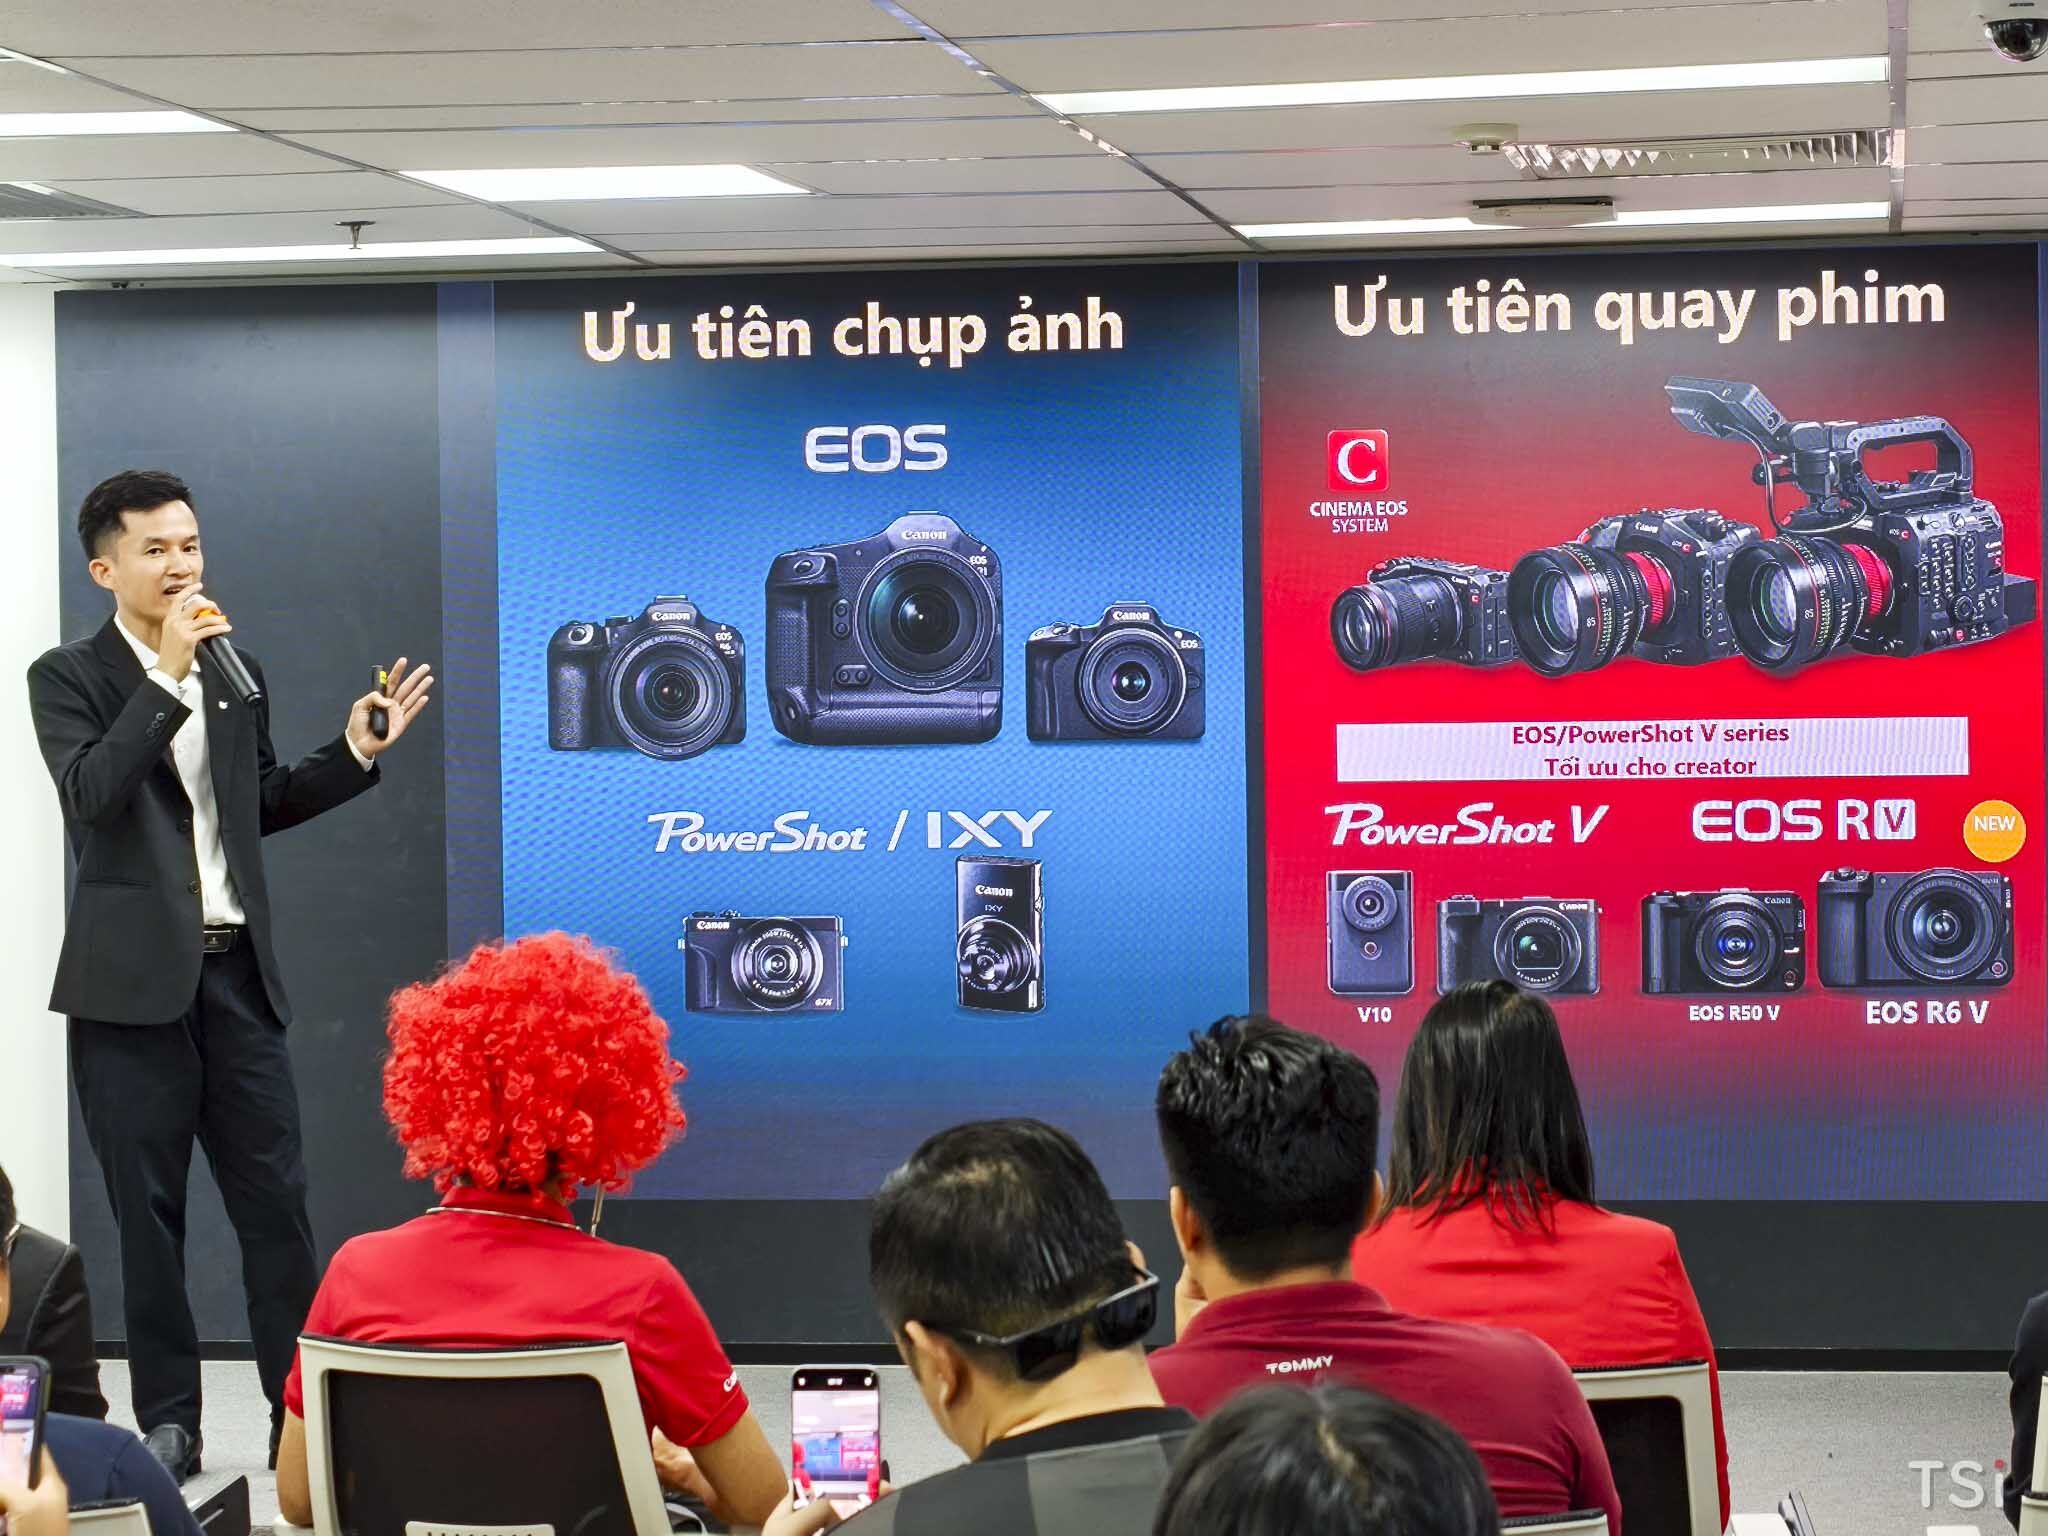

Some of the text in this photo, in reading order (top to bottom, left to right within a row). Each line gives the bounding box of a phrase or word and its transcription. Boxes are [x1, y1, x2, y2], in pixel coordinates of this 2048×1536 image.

[1334, 269, 1945, 345] Ưu tiên quay phim
[583, 296, 1123, 367] Ưu tiên chụp ảnh
[805, 424, 948, 472] EOS
[1337, 438, 1377, 484] C
[1310, 501, 1408, 516] CINEMA EOS
[1332, 518, 1389, 533] SYSTEM
[901, 529, 948, 540] Canon
[970, 555, 987, 565] EOS
[652, 612, 690, 621] Canon
[1112, 610, 1150, 620] Canon
[715, 632, 732, 641] EOS
[1180, 640, 1198, 648] EOS
[1513, 722, 1790, 746] EOS/PowerShot V series
[1544, 755, 1757, 776] Tối ưu cho creator
[1324, 802, 1610, 846] PowerShot V
[1692, 799, 1823, 842] EOS
[1974, 815, 2016, 832] NEW
[647, 810, 868, 853] PowerShot
[926, 809, 1053, 849] IXY
[975, 885, 1013, 897] Canon
[985, 904, 1003, 912] IXY
[1558, 902, 1588, 911] Canon
[1764, 896, 1791, 905] Canon
[697, 921, 730, 931] Canon
[1357, 1007, 1392, 1023] V10
[1689, 1005, 1780, 1021] EOS R50 V
[1866, 1000, 1989, 1024] EOS R6 V
[1265, 1355, 1333, 1375] TOMMY
